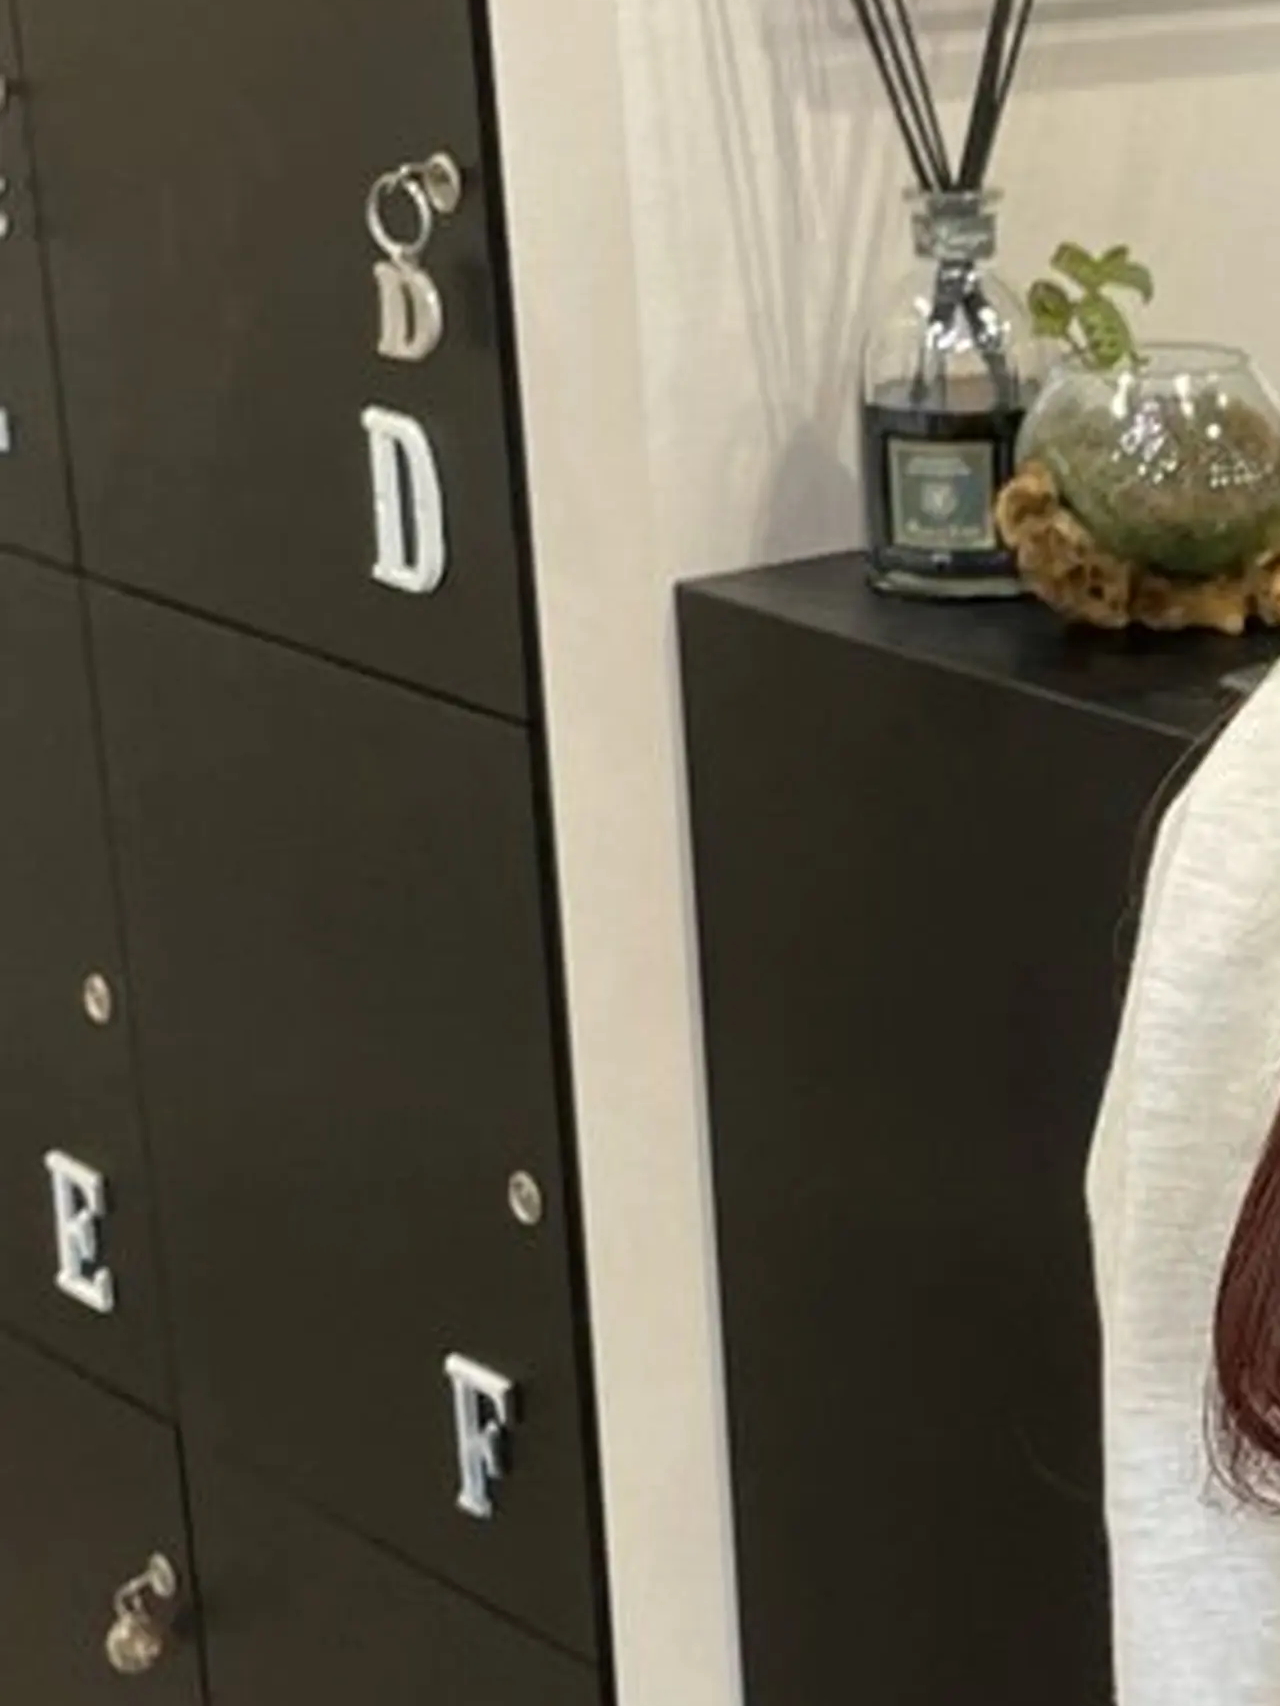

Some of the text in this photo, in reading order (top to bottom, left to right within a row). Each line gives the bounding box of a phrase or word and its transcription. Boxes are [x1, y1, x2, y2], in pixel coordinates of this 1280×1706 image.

[373, 260, 443, 360] D
[361, 403, 449, 595] D
[44, 1148, 114, 1315] E
[444, 1352, 518, 1518] F
